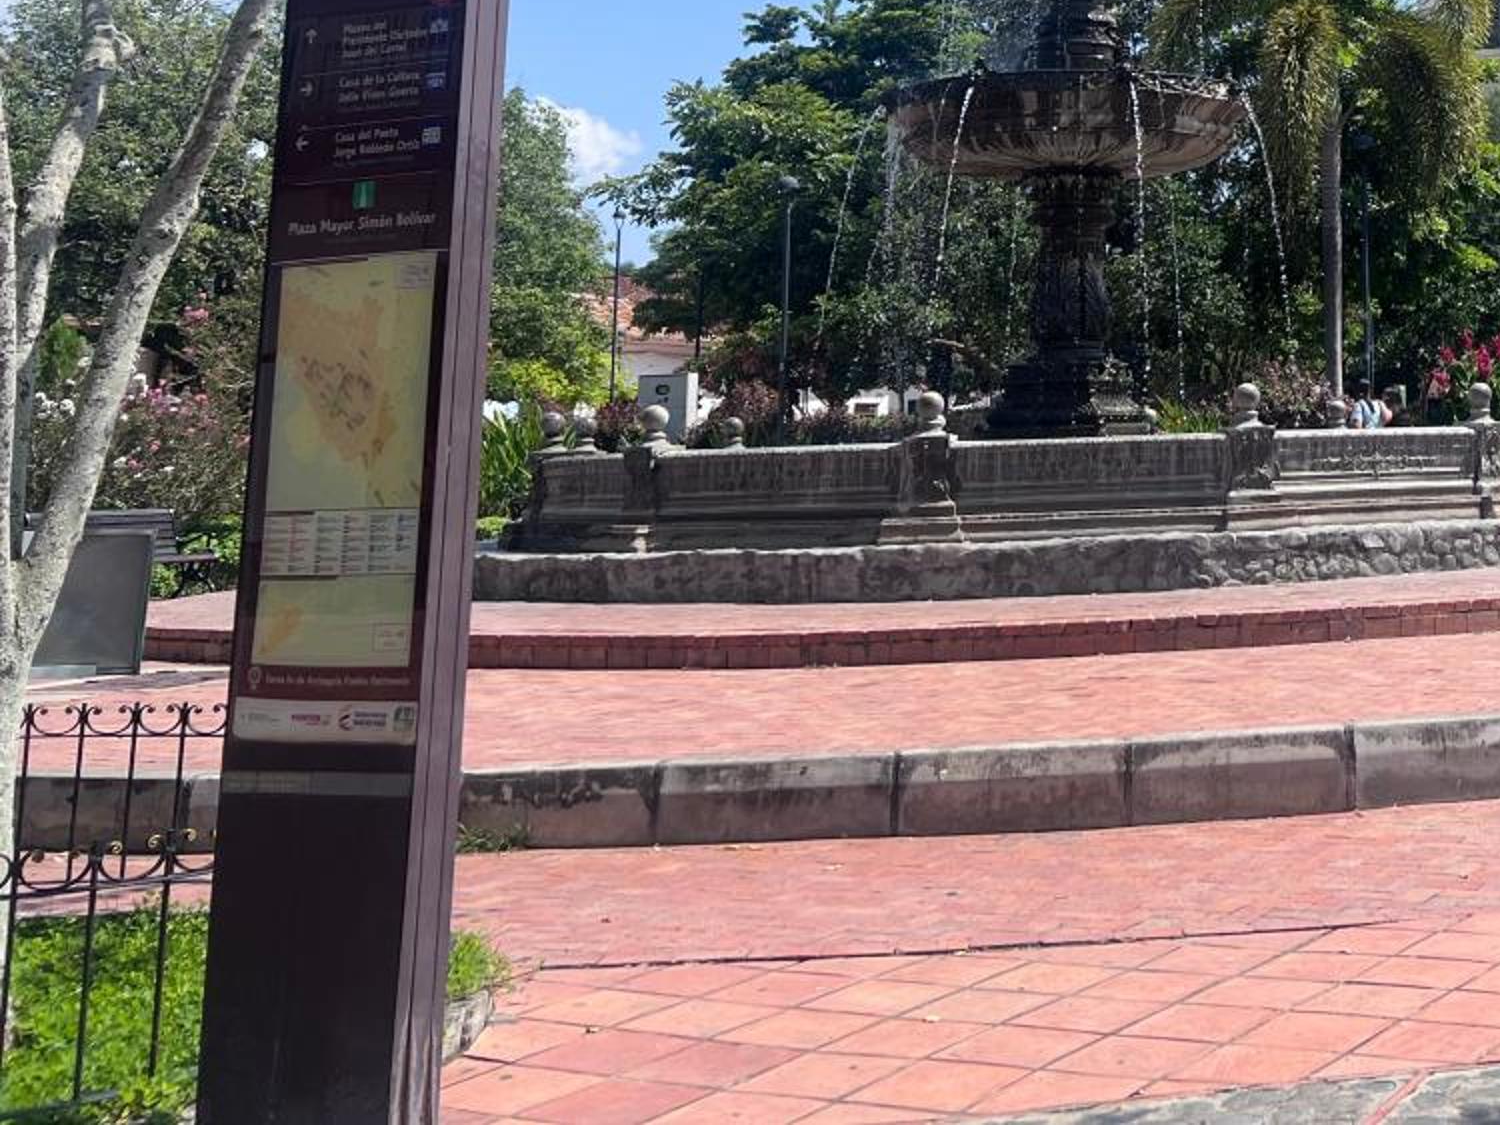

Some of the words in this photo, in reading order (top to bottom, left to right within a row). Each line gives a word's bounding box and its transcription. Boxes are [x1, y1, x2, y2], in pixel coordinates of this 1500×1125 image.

[339, 75, 361, 87] Casa
[362, 74, 374, 85] de
[376, 73, 385, 84] la
[387, 71, 420, 83] Cultura
[336, 131, 355, 142] Casa
[358, 129, 372, 140] del
[287, 221, 317, 235] Plaza
[320, 218, 355, 236] Mayor
[357, 213, 393, 230] Simón
